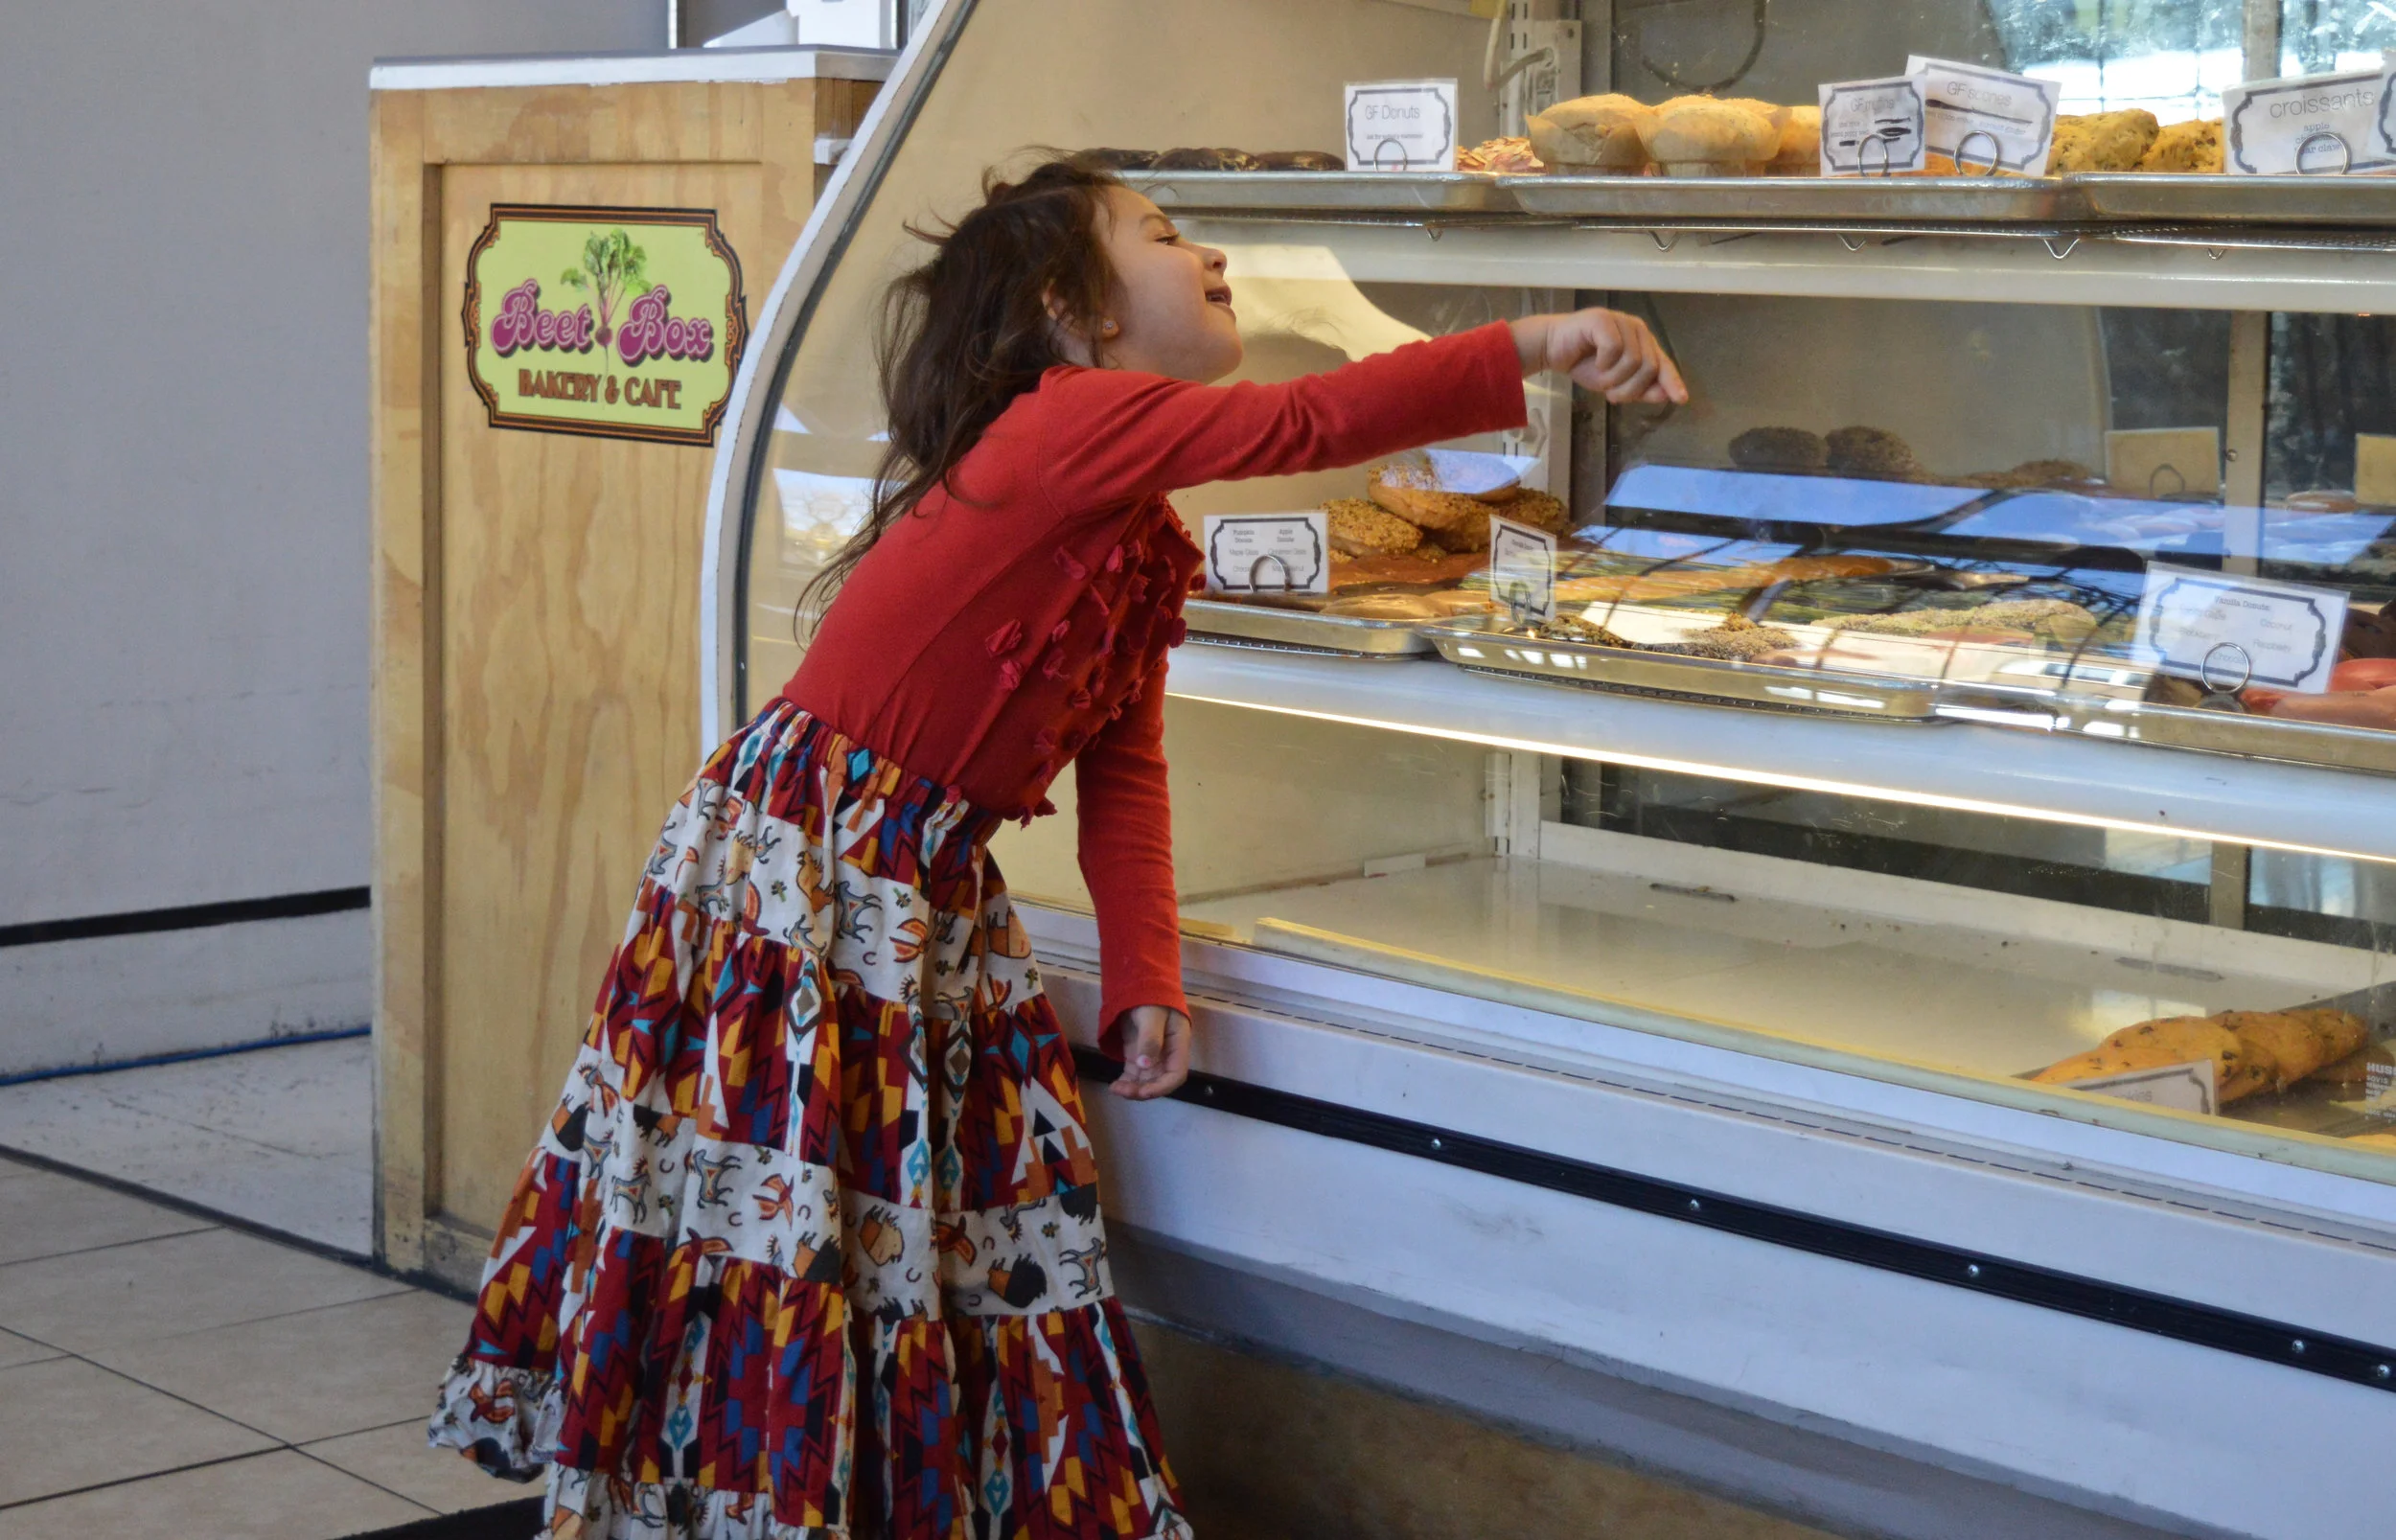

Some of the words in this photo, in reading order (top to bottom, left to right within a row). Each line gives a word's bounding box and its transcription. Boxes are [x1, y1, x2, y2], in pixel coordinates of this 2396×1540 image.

[1947, 81, 1967, 96] GF
[1968, 88, 2012, 106] scones
[2269, 88, 2375, 118] croissants
[1365, 104, 1379, 120] GF
[1382, 104, 1420, 120] Donuts
[1851, 98, 1864, 112] GF
[2303, 123, 2330, 132] apple
[491, 279, 593, 357] Beet
[617, 285, 713, 366] Box
[518, 368, 602, 402] BAKERY
[605, 375, 620, 404] &
[625, 377, 682, 409] CAFE
[2214, 595, 2241, 608] Vanilla
